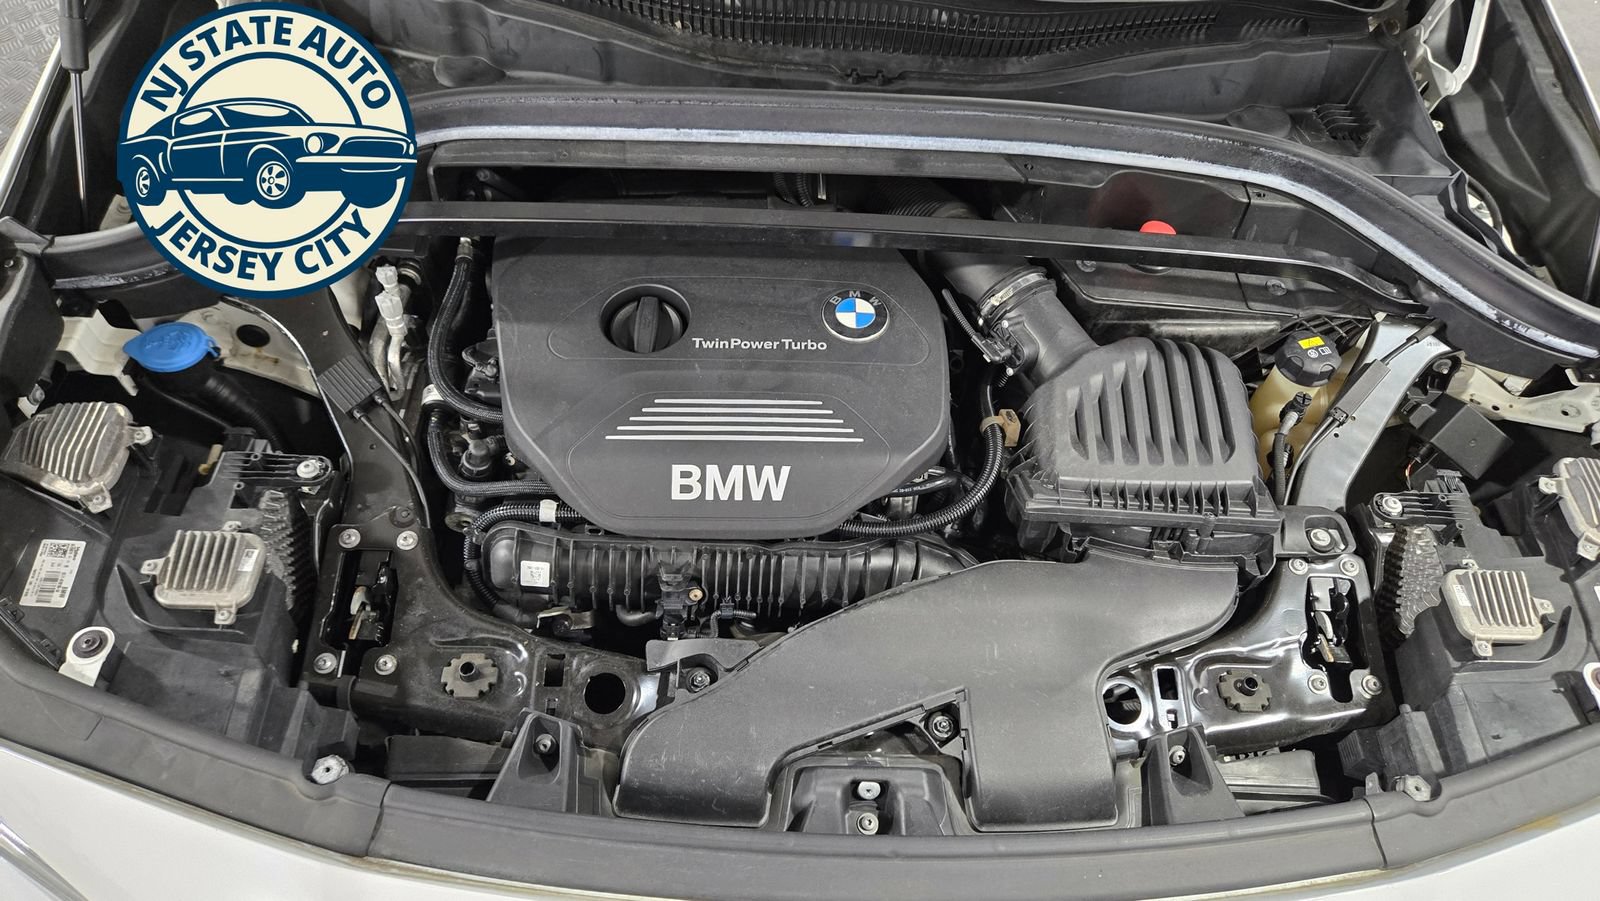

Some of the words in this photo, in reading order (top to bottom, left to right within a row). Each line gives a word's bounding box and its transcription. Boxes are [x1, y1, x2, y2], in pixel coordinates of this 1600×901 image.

[829, 290, 882, 307] BMW
[691, 337, 780, 350] TwinPower
[781, 338, 828, 351] Turbo
[670, 464, 792, 502] BMW
